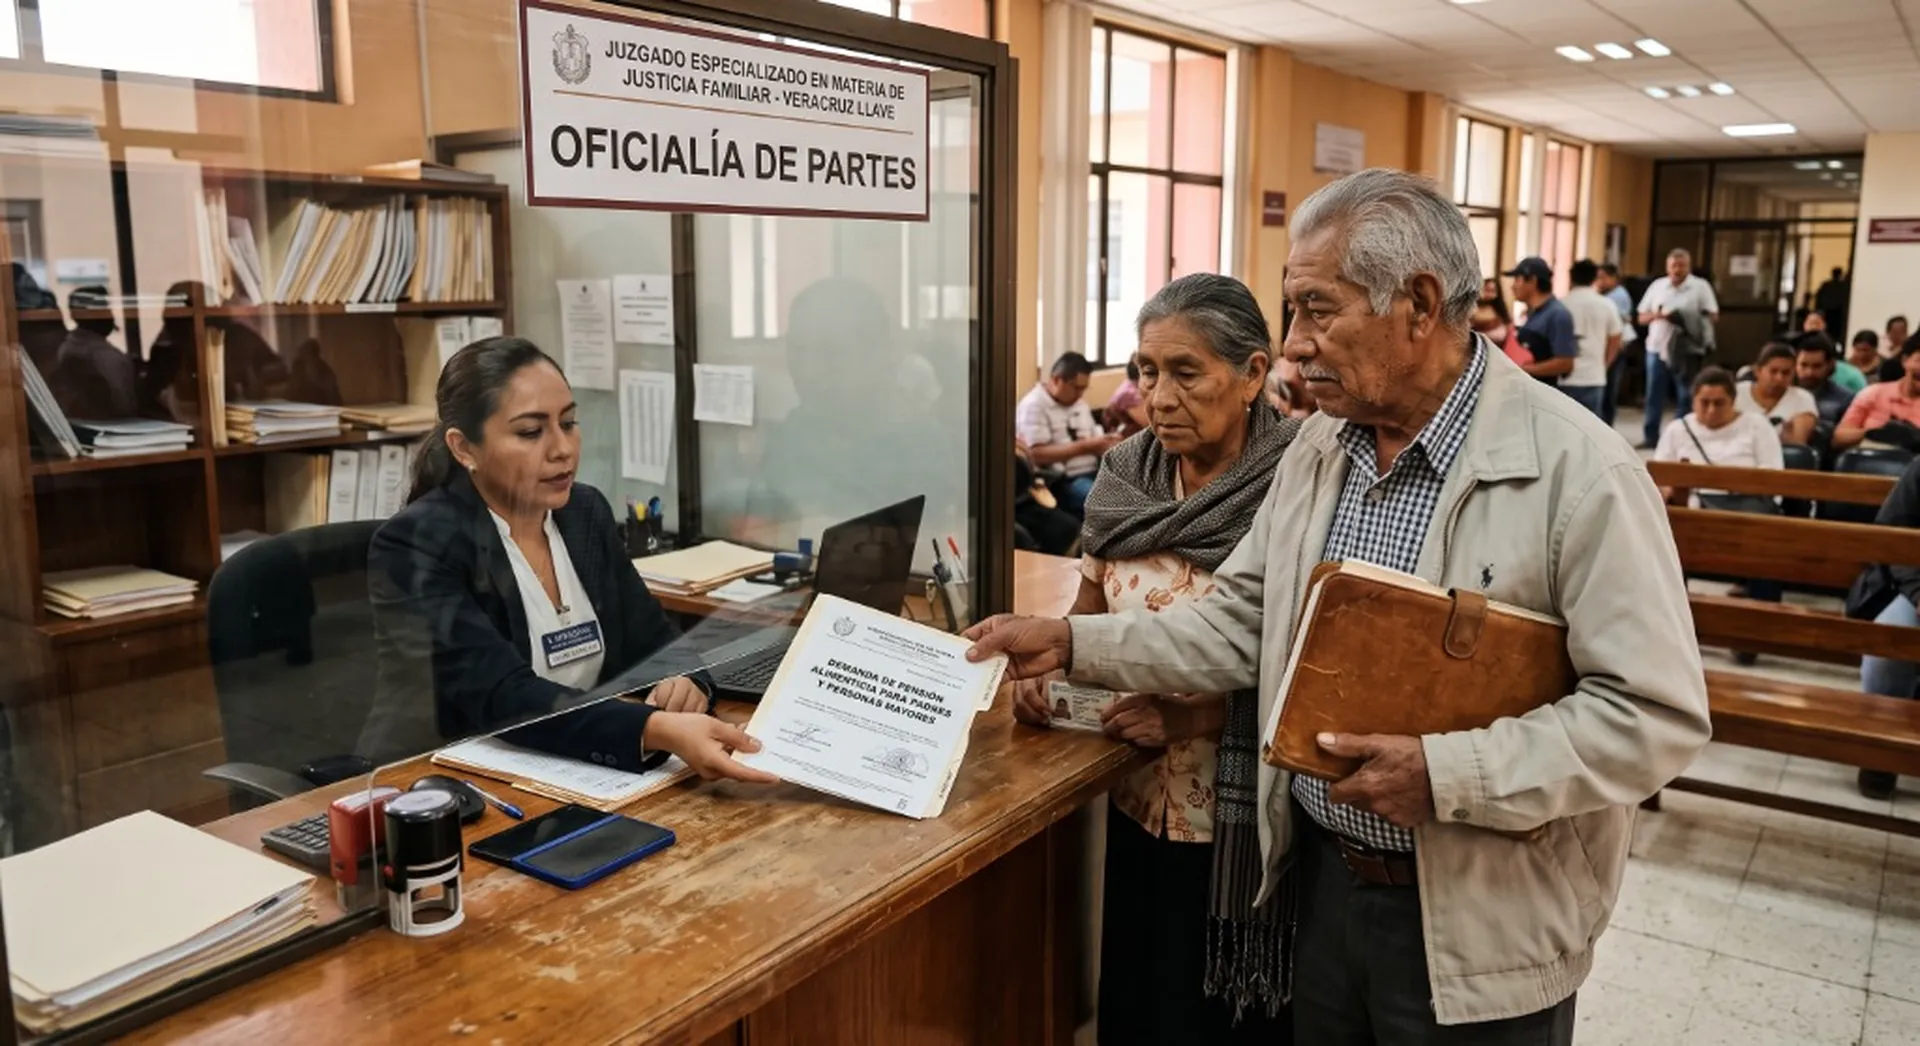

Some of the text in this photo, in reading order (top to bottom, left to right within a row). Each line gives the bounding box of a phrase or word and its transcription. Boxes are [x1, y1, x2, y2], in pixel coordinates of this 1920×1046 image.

[605, 40, 905, 100] JUZGADO ESPECIALIZADO EN MATERIA DE
[622, 69, 698, 94] JUSTICIA
[702, 78, 771, 104] FAMILIAR
[783, 90, 854, 114] VERACRUZ
[857, 101, 896, 120] LLAVE
[551, 124, 917, 190] OFICIALÍA DE PARTES
[811, 665, 877, 694] ALIMENTICIA
[879, 688, 907, 703] PARA
[909, 698, 952, 718] PADRES
[828, 658, 879, 681] DEMANDA
[881, 676, 897, 687] DE
[818, 679, 826, 688] Y
[826, 682, 883, 707] PERSONAS
[884, 702, 937, 724] MAYORES
